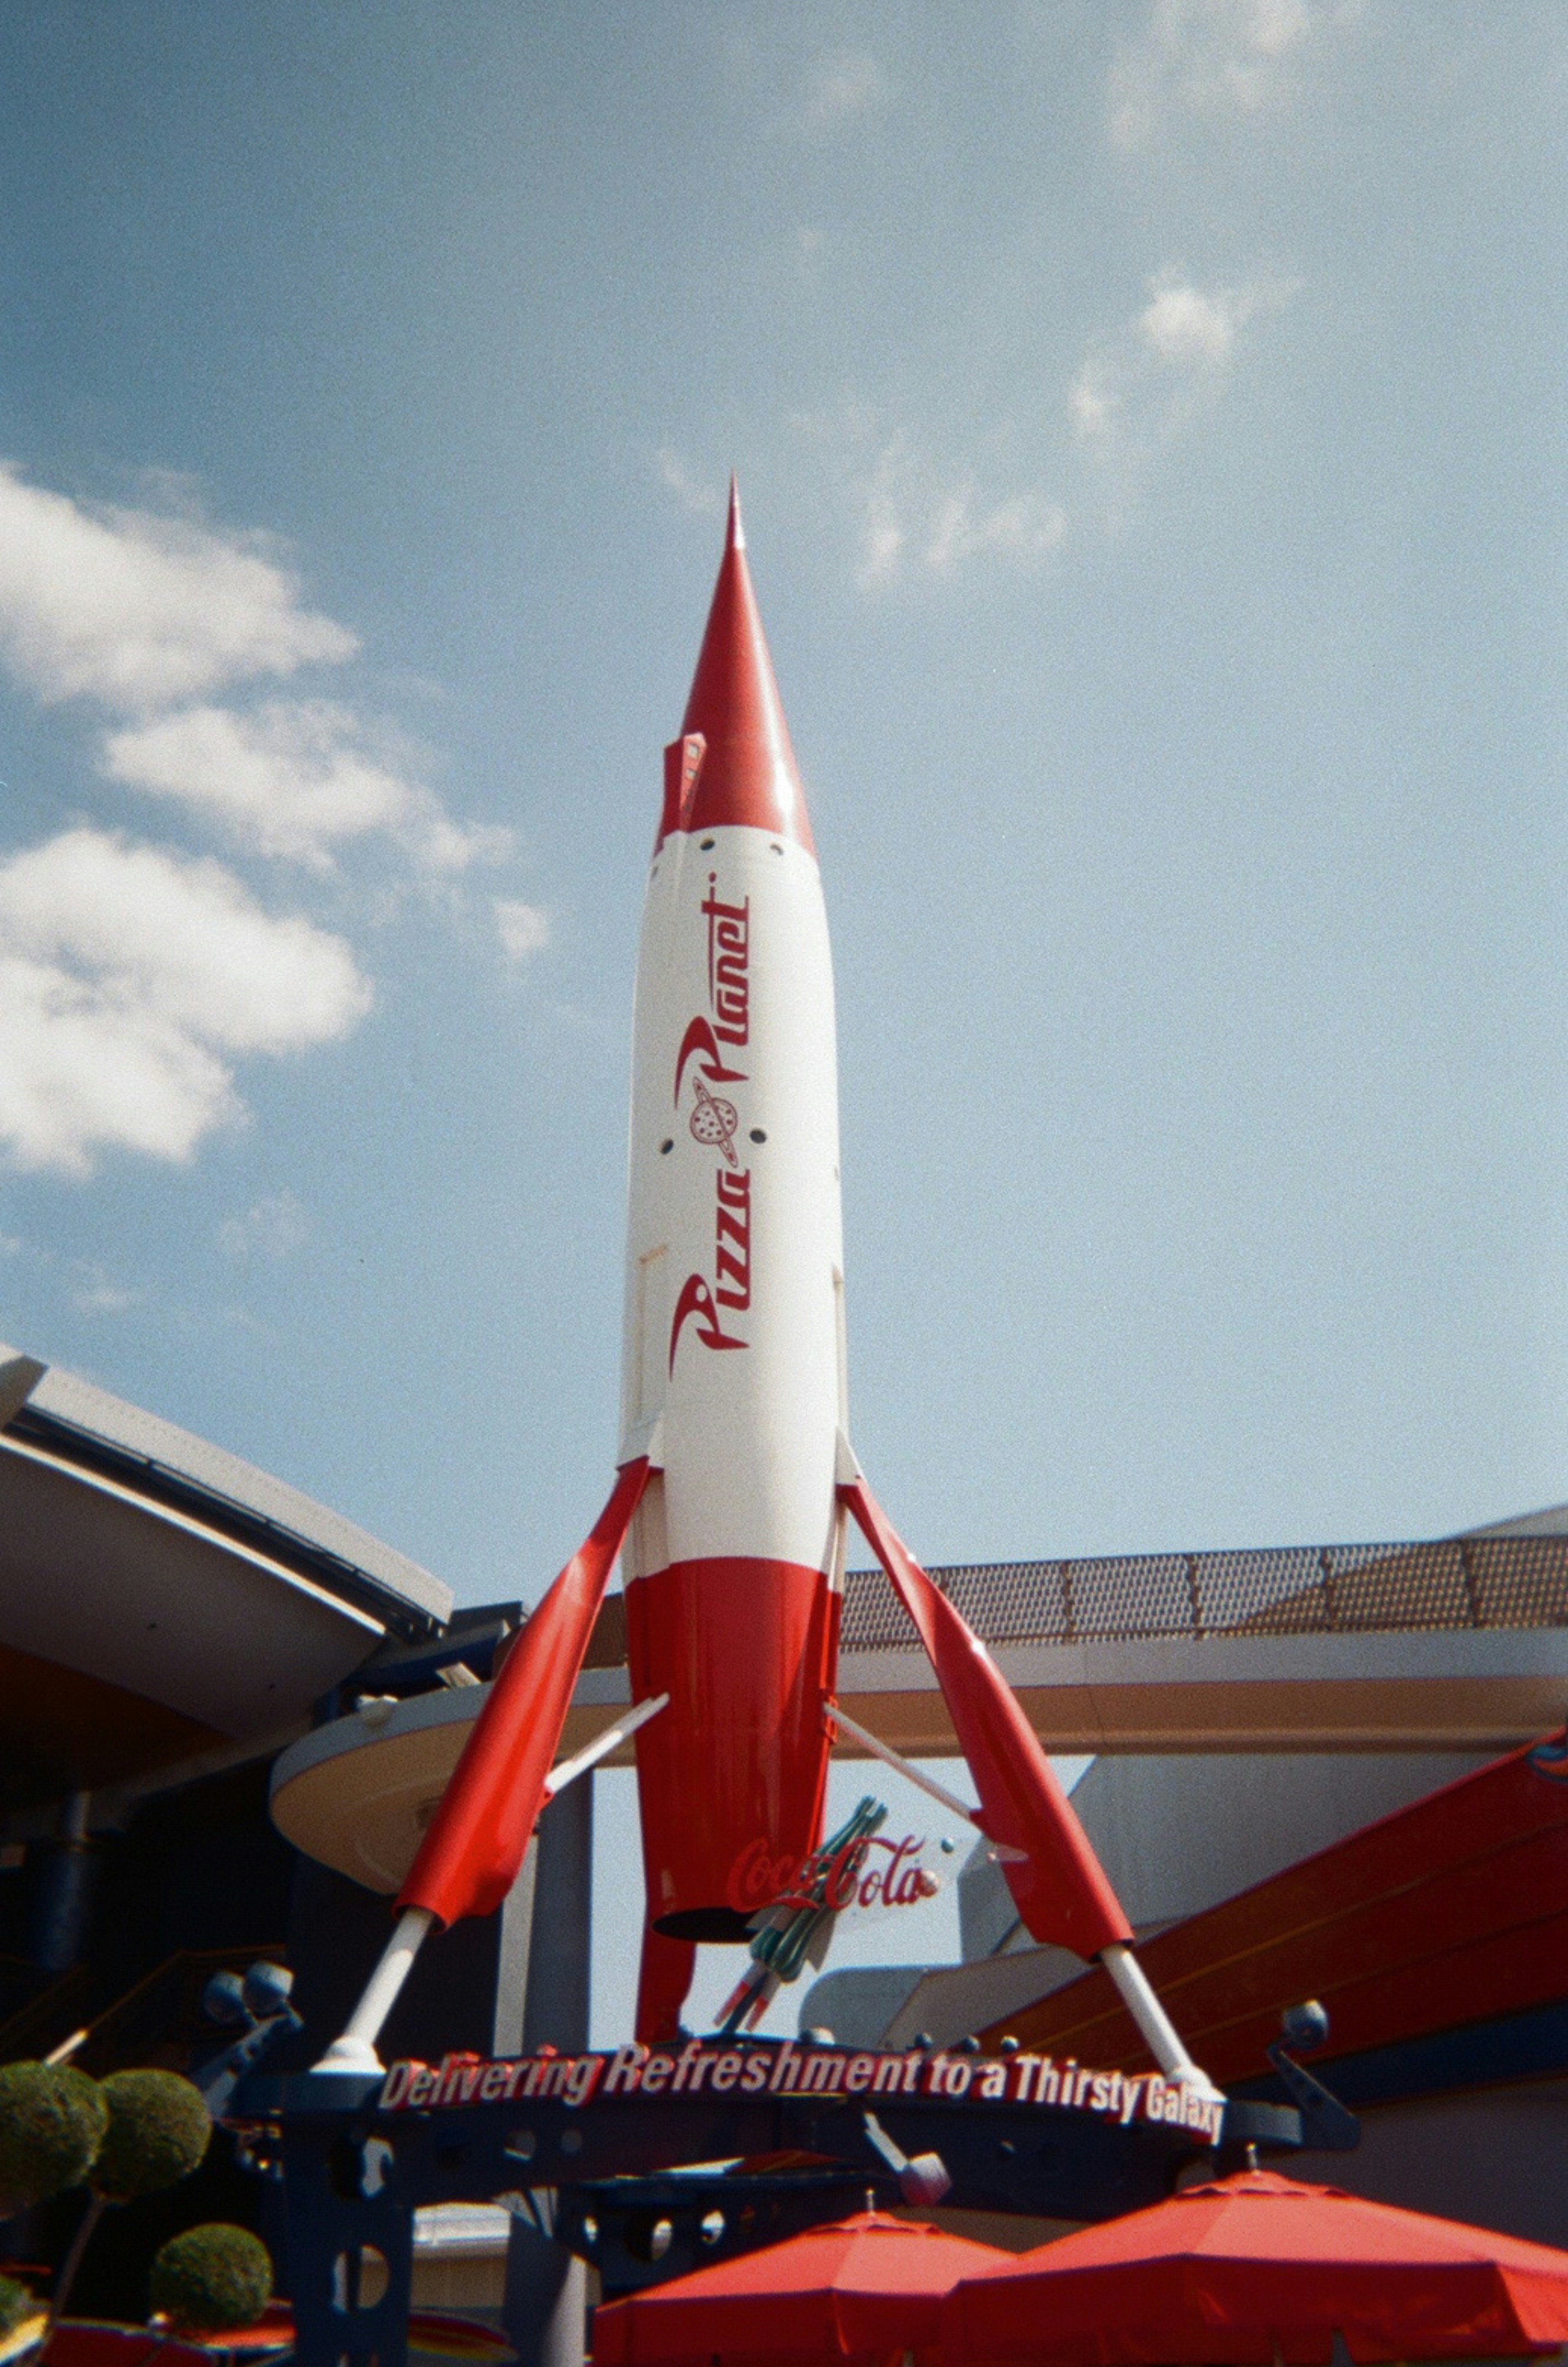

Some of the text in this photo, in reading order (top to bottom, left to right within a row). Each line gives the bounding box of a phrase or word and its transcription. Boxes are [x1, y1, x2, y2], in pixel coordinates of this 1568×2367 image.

[669, 873, 750, 1382] Pizza Planet
[378, 2039, 1224, 2146] Delivering Refreshment to a Thirsty Galaxy
